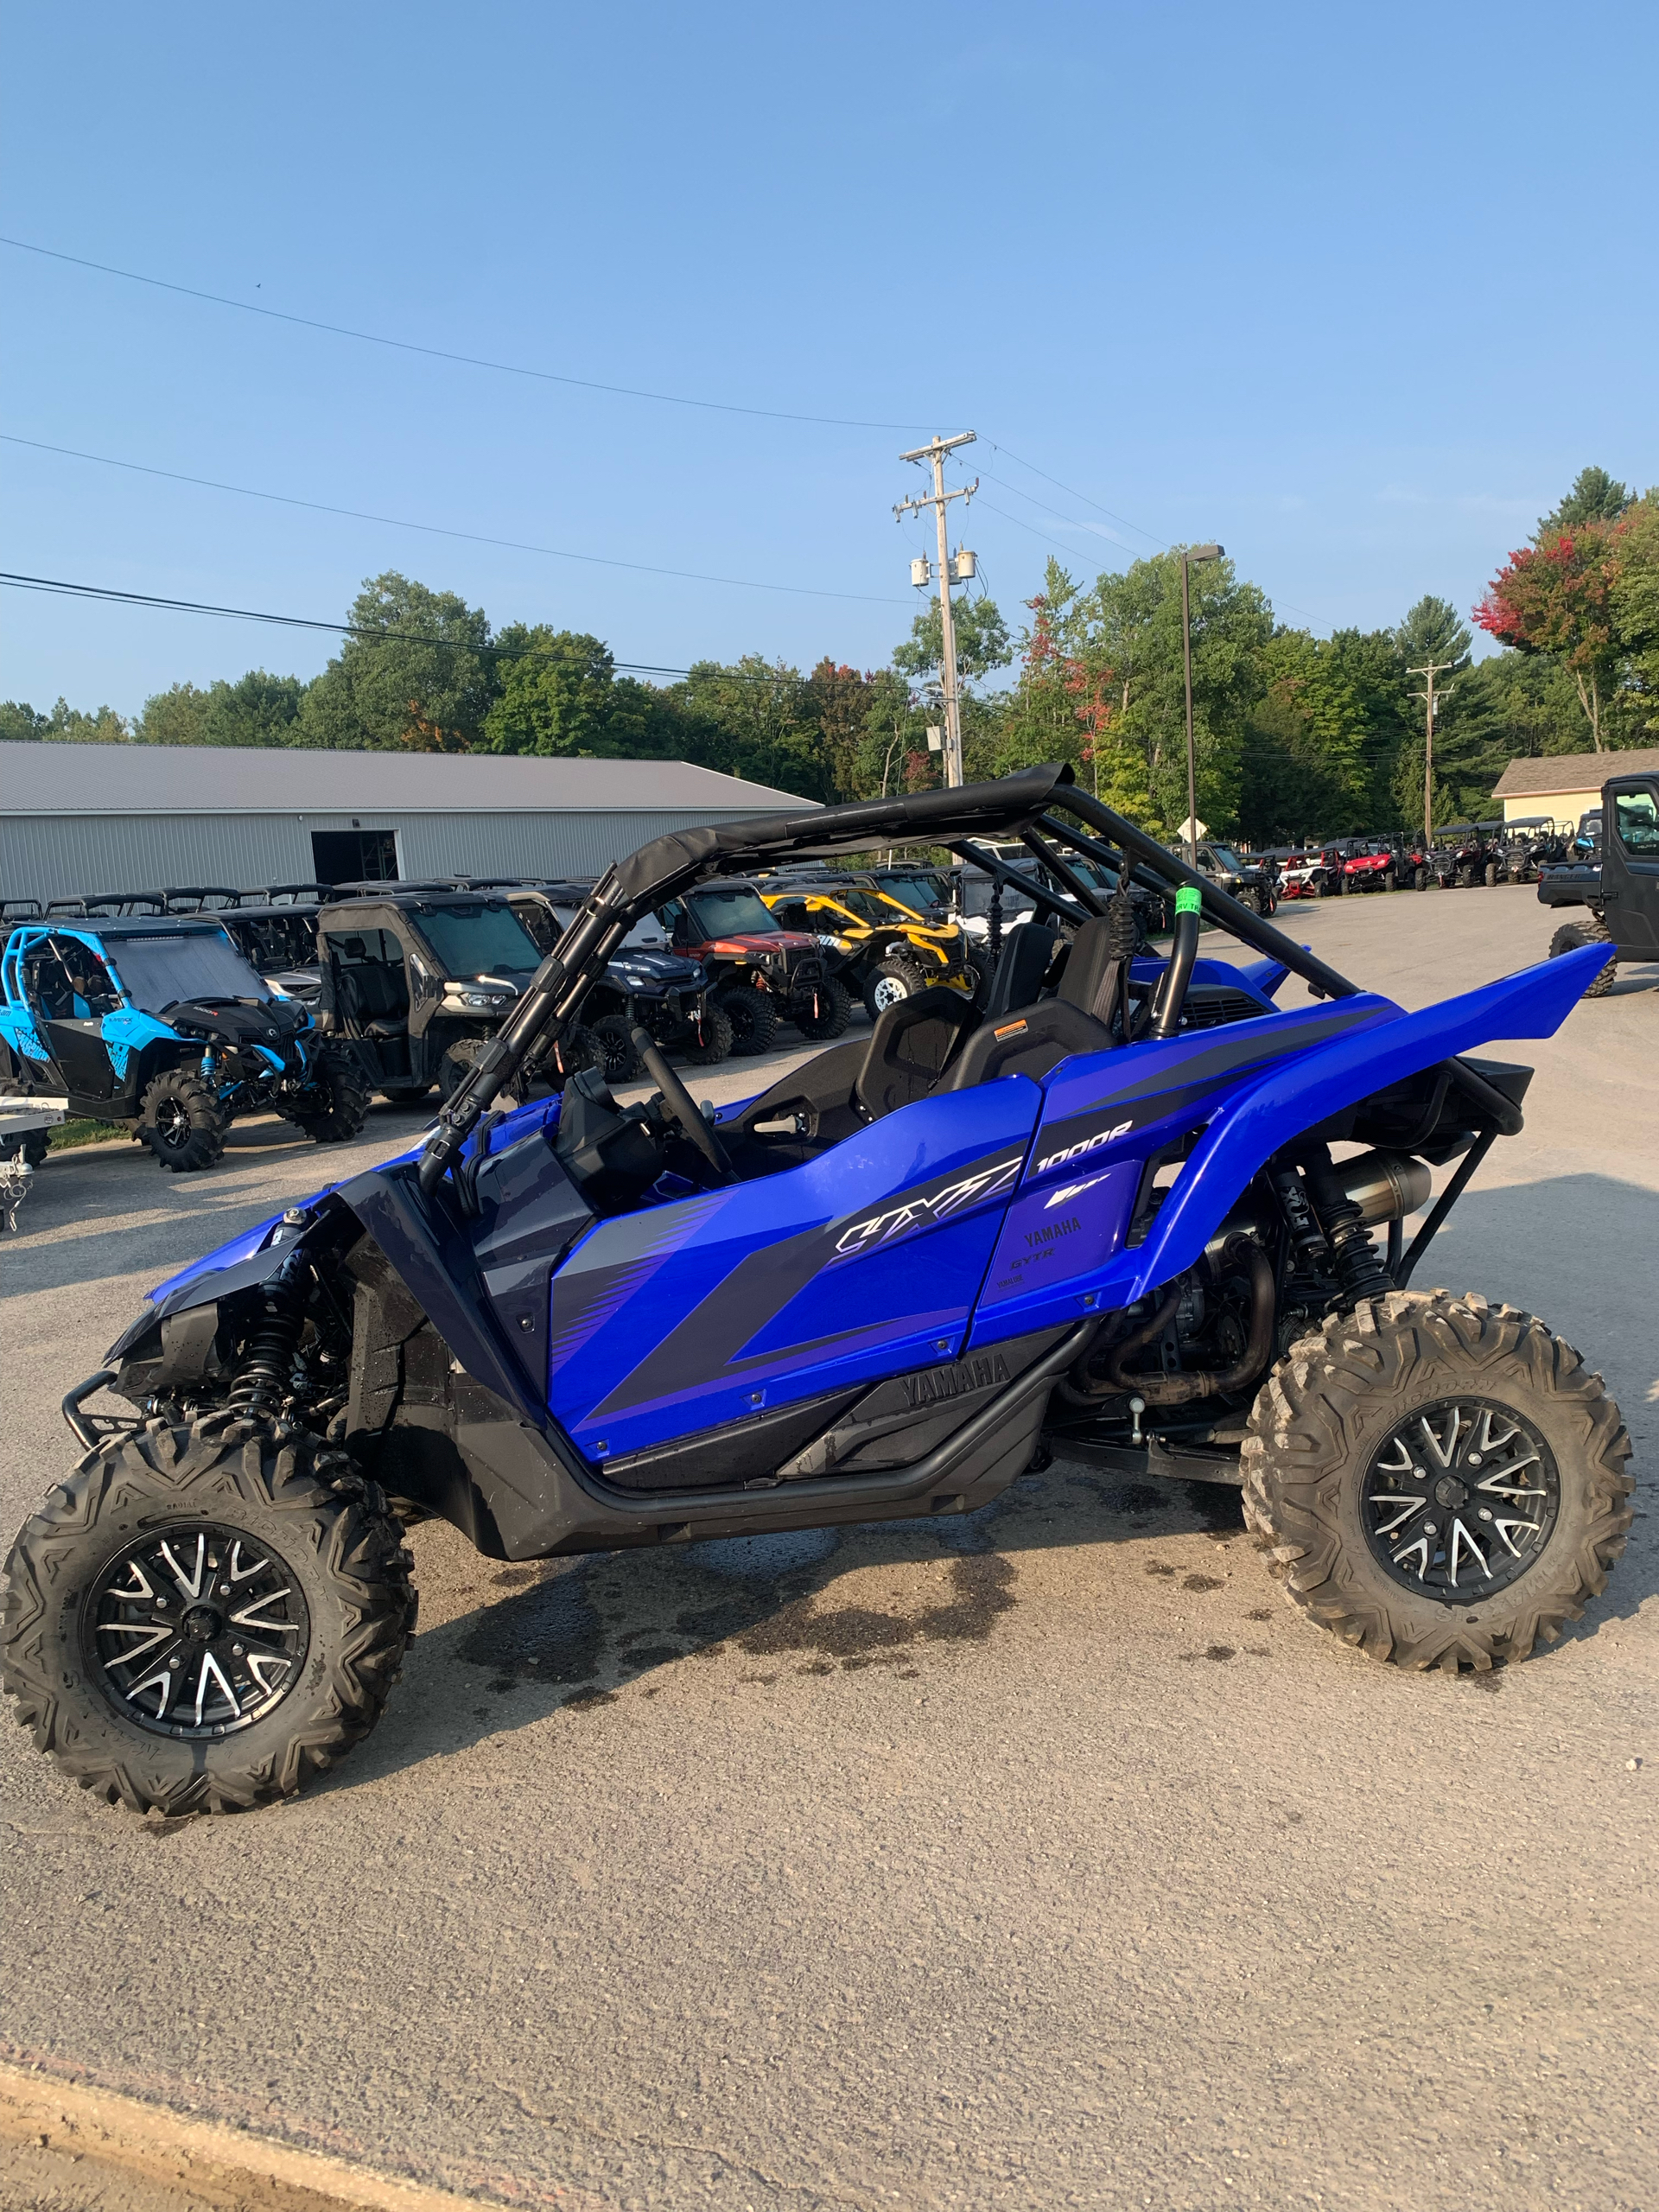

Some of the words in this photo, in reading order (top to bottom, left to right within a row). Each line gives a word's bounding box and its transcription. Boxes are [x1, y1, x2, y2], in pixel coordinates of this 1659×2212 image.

[1036, 1120, 1133, 1173] 1000R
[1280, 1186, 1310, 1229] FOX
[1024, 1217, 1082, 1248] YAMAHA
[1009, 1247, 1056, 1271] GYTR
[996, 1274, 1024, 1289] YAMALUBE
[899, 1353, 1011, 1406] YAMAHA
[1435, 1571, 1548, 1623] MAXXIS
